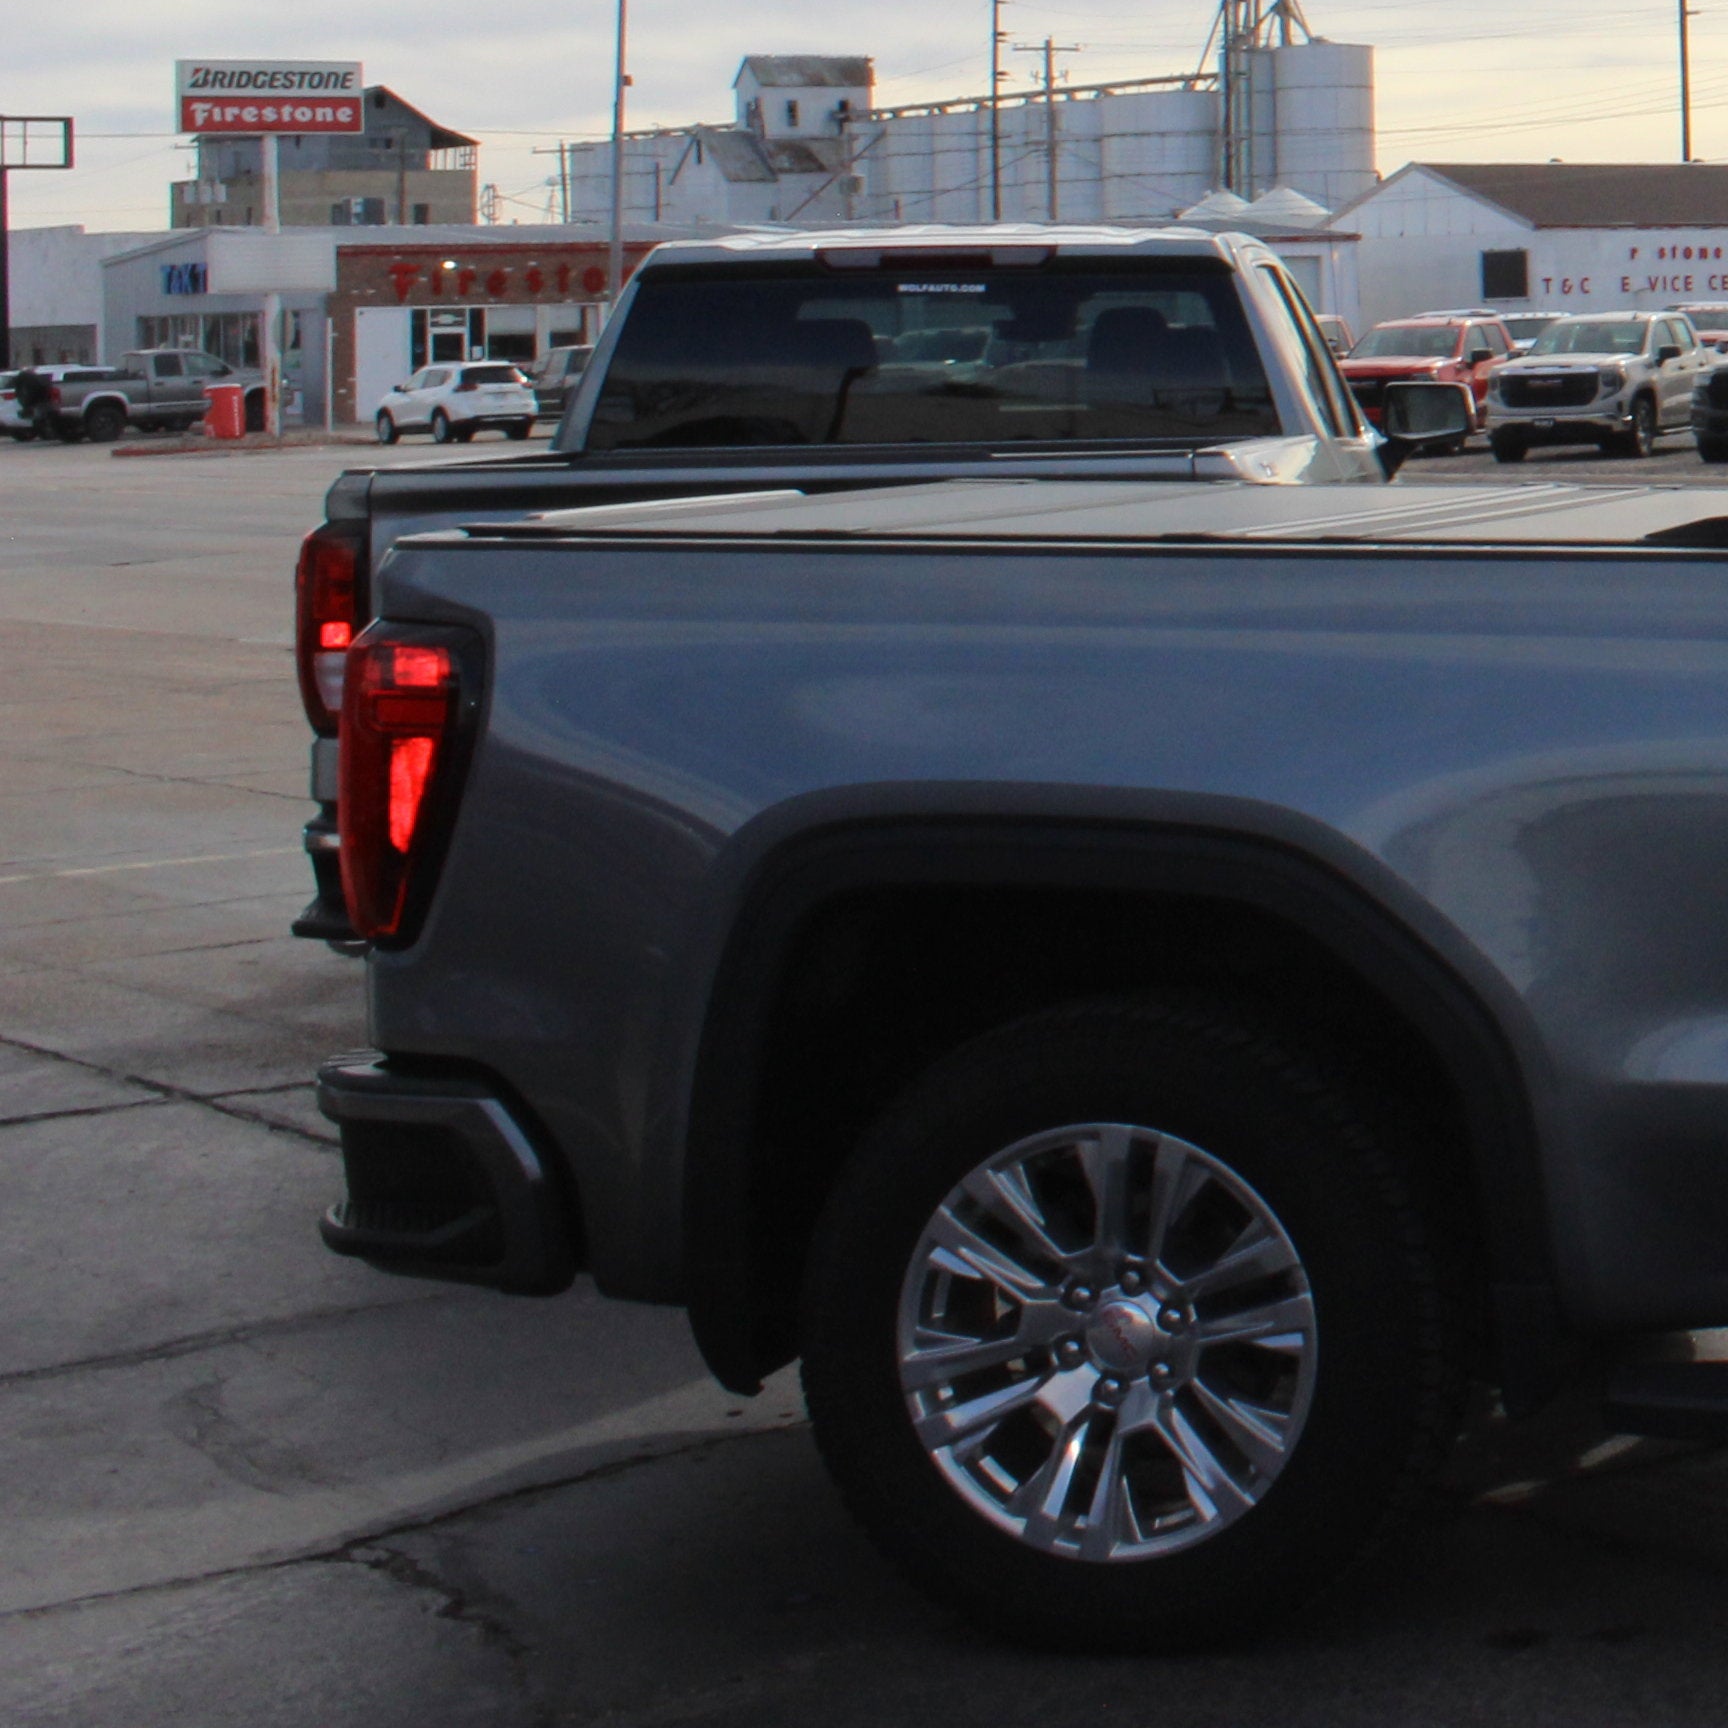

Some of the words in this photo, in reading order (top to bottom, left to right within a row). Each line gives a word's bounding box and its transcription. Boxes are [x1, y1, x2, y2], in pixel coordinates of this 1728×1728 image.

[189, 67, 354, 90] BRIDGESTONE
[189, 102, 354, 127] Firestone
[389, 262, 638, 303] Firesto
